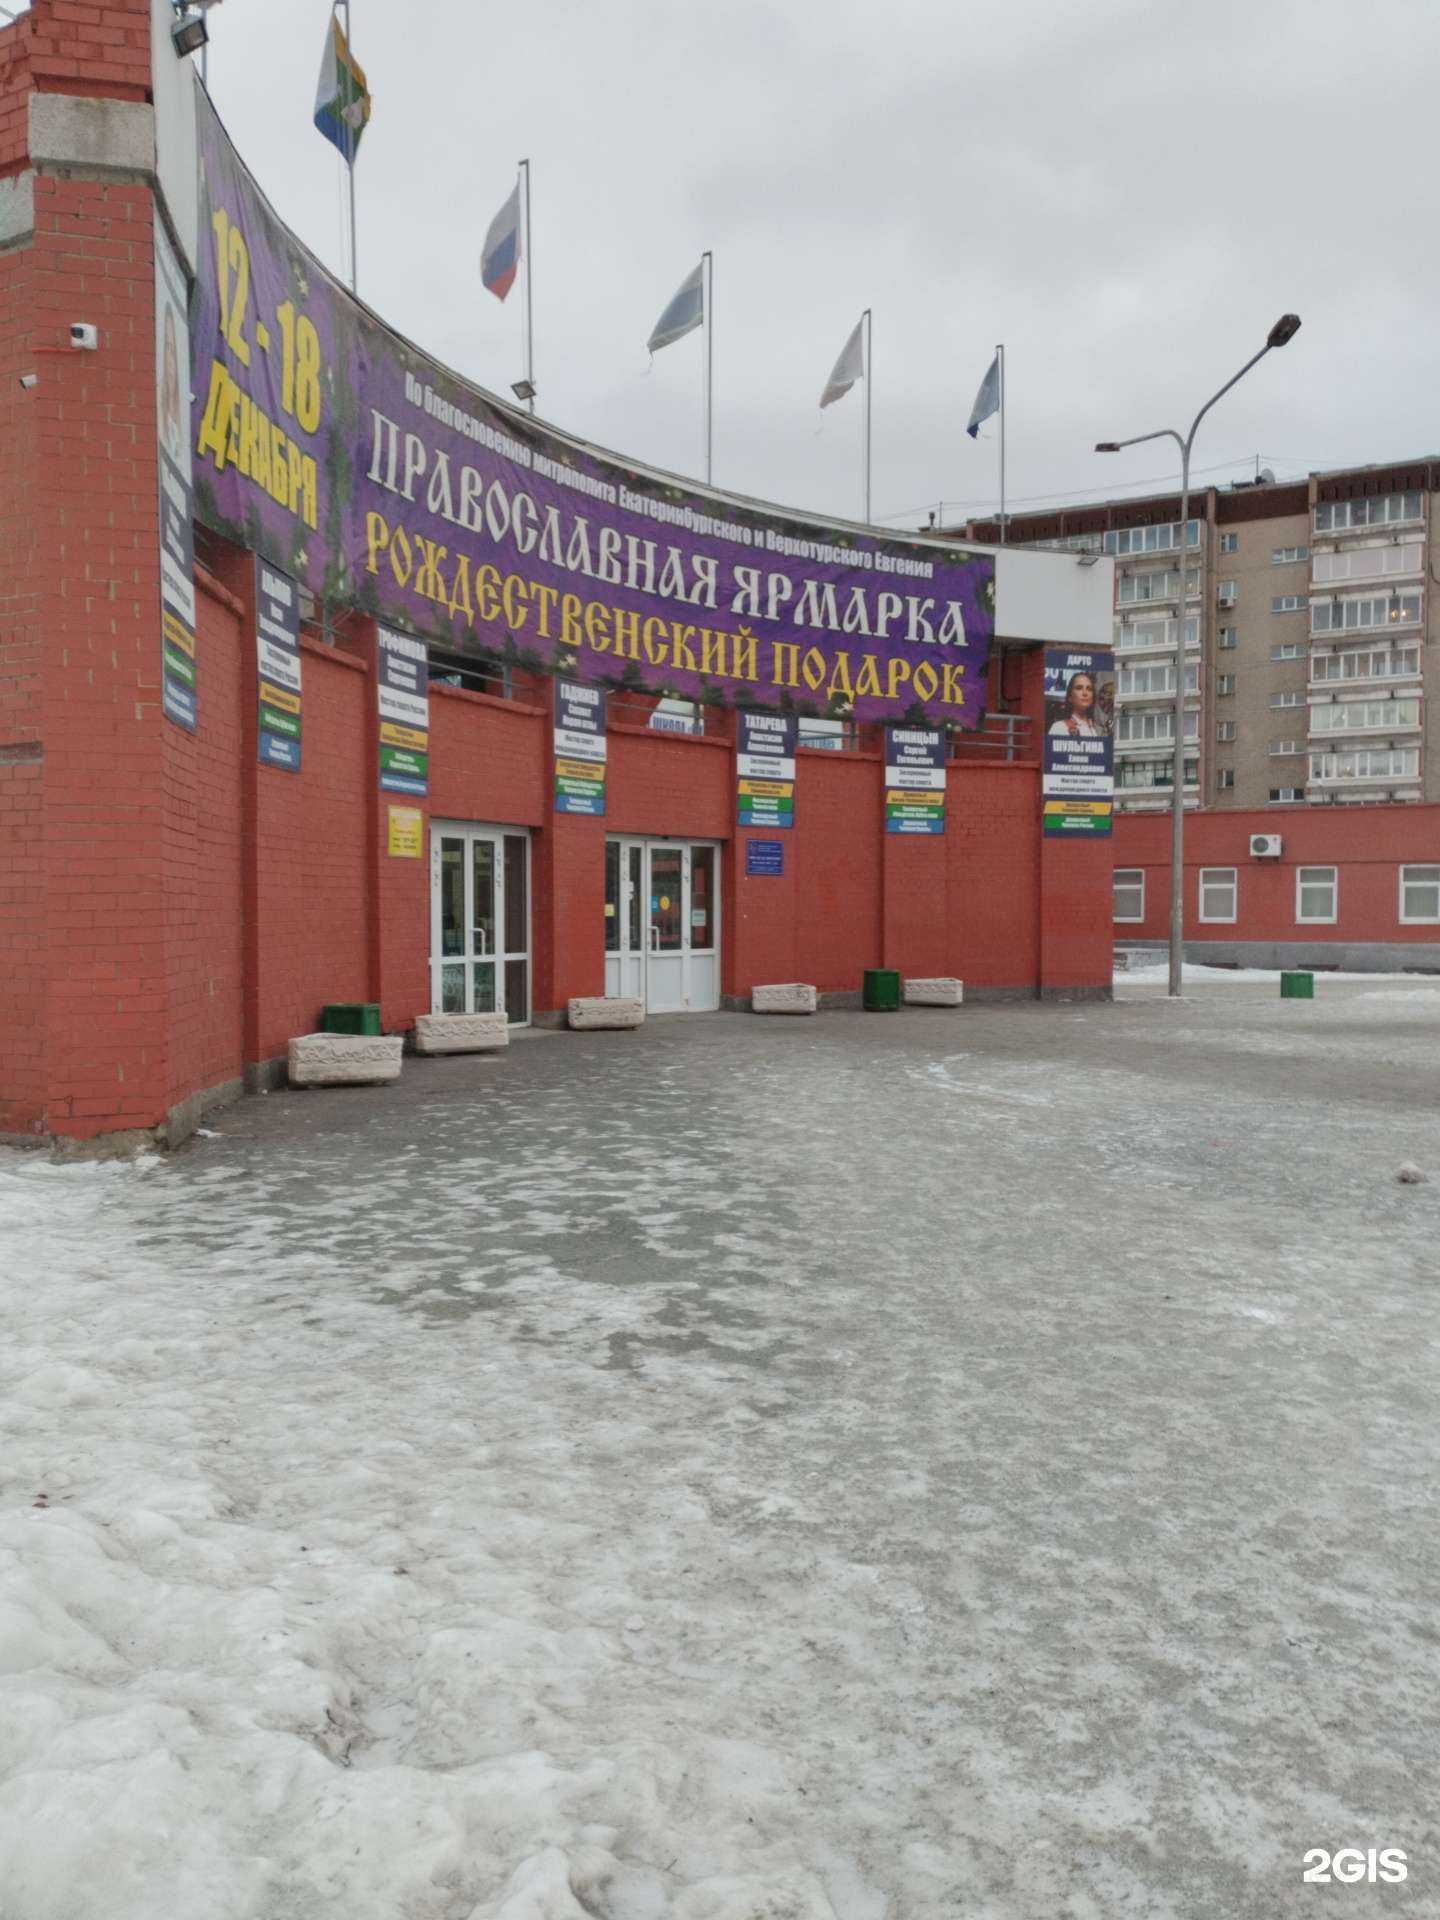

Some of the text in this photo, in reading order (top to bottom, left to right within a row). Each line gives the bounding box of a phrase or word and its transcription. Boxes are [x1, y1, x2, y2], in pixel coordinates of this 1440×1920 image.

[197, 358, 318, 531] ДЕКАБРЯ
[366, 408, 969, 647] ПРАВОСЛАВНАЯ ЯРМАРКА
[405, 370, 934, 580] По благословению митрополита Екатеринбургского и Верхотурского Евгения
[365, 510, 966, 705] РОЖДЕСТВЕНСКИЙ ПОДАРОК
[1066, 655, 1093, 667] ДАРТС
[892, 730, 939, 745] СИНИЦЫН
[1052, 739, 1105, 754] ШУЛЬГИНА
